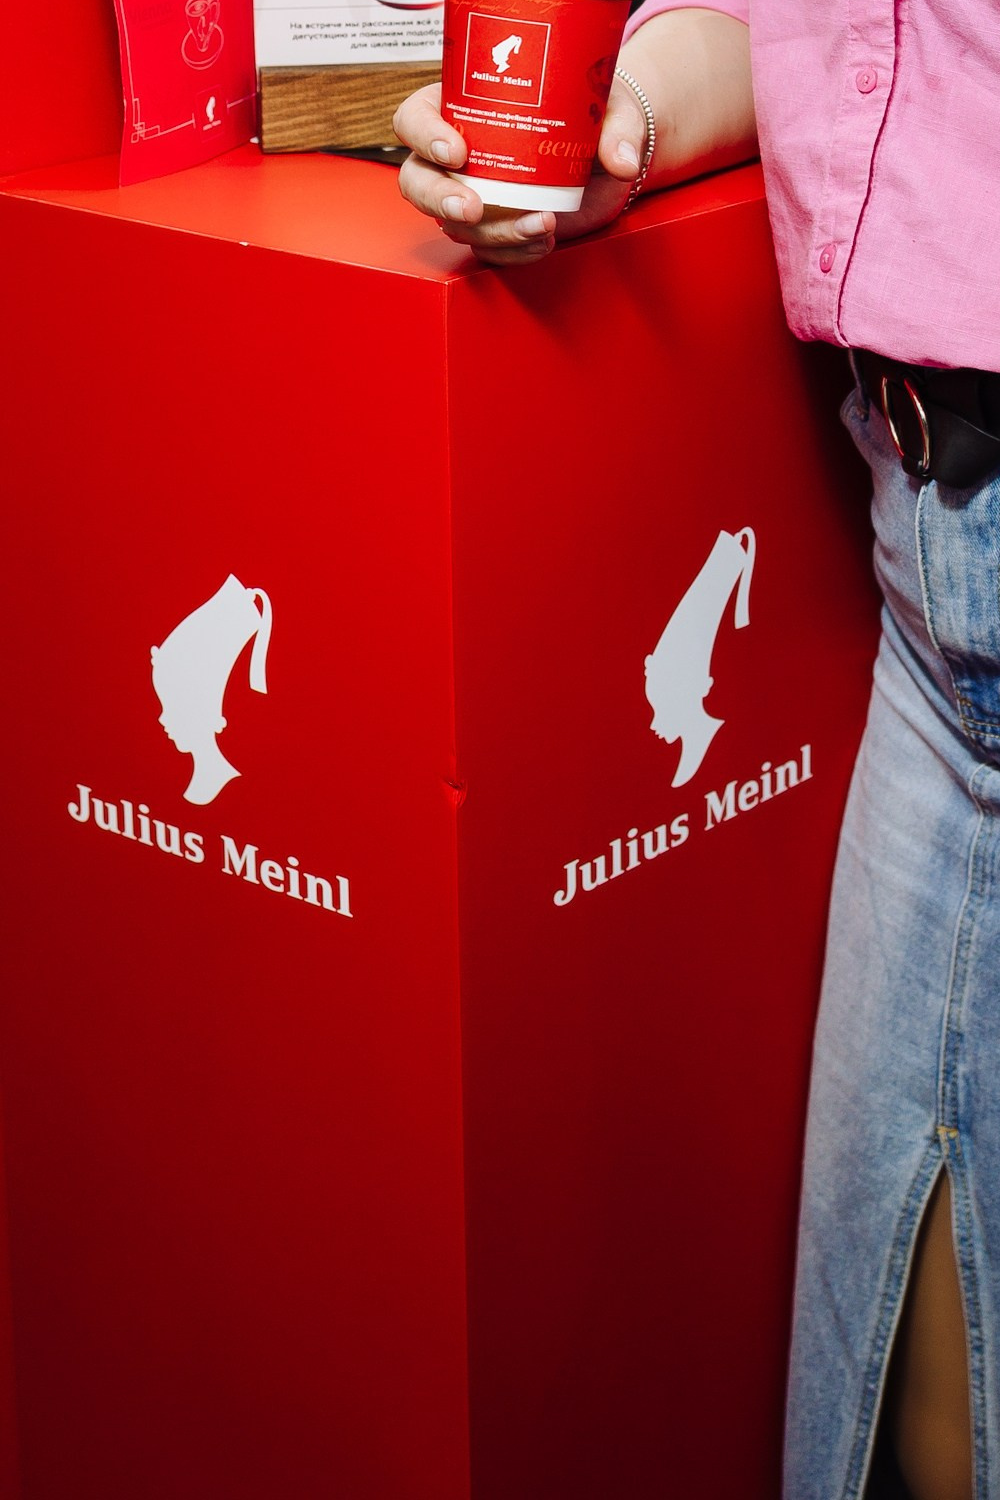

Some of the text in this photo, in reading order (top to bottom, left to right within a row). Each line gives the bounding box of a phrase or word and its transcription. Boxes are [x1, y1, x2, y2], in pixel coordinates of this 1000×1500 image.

[471, 71, 532, 87] Julius Meinl
[516, 122, 532, 132] 1862
[68, 783, 354, 919] Julius Meinl
[553, 743, 814, 908] Julius Meinl
